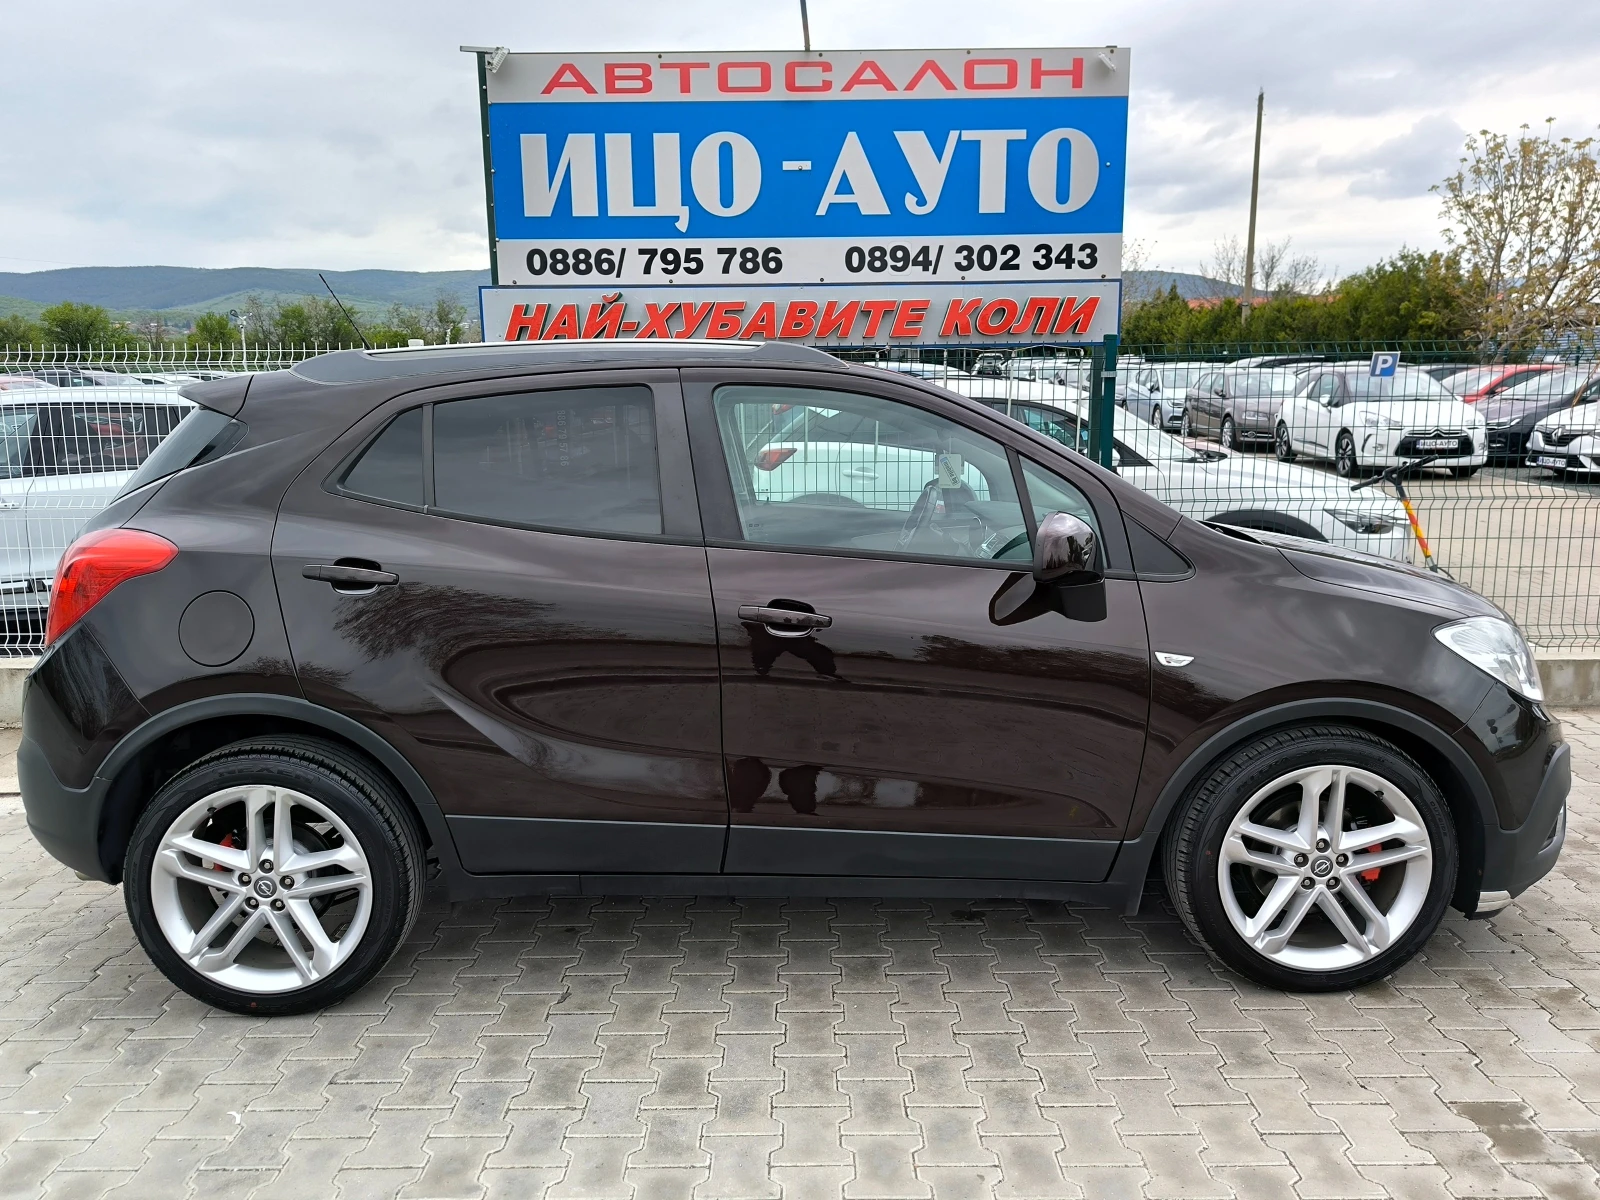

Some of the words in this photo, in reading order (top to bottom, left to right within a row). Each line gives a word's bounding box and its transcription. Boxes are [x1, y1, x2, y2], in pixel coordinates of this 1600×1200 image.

[541, 58, 1084, 95] АВТОСАЛОН
[526, 248, 626, 278] 0886/
[638, 248, 704, 275] 795
[717, 247, 783, 275] 786
[845, 245, 944, 275] 0894/
[954, 244, 1020, 271] 302
[1032, 243, 1098, 270] 343
[504, 291, 931, 341] НАЙ-ХУБАВИТЕ
[939, 296, 1100, 336] КОЛИ
[1375, 355, 1393, 374] P
